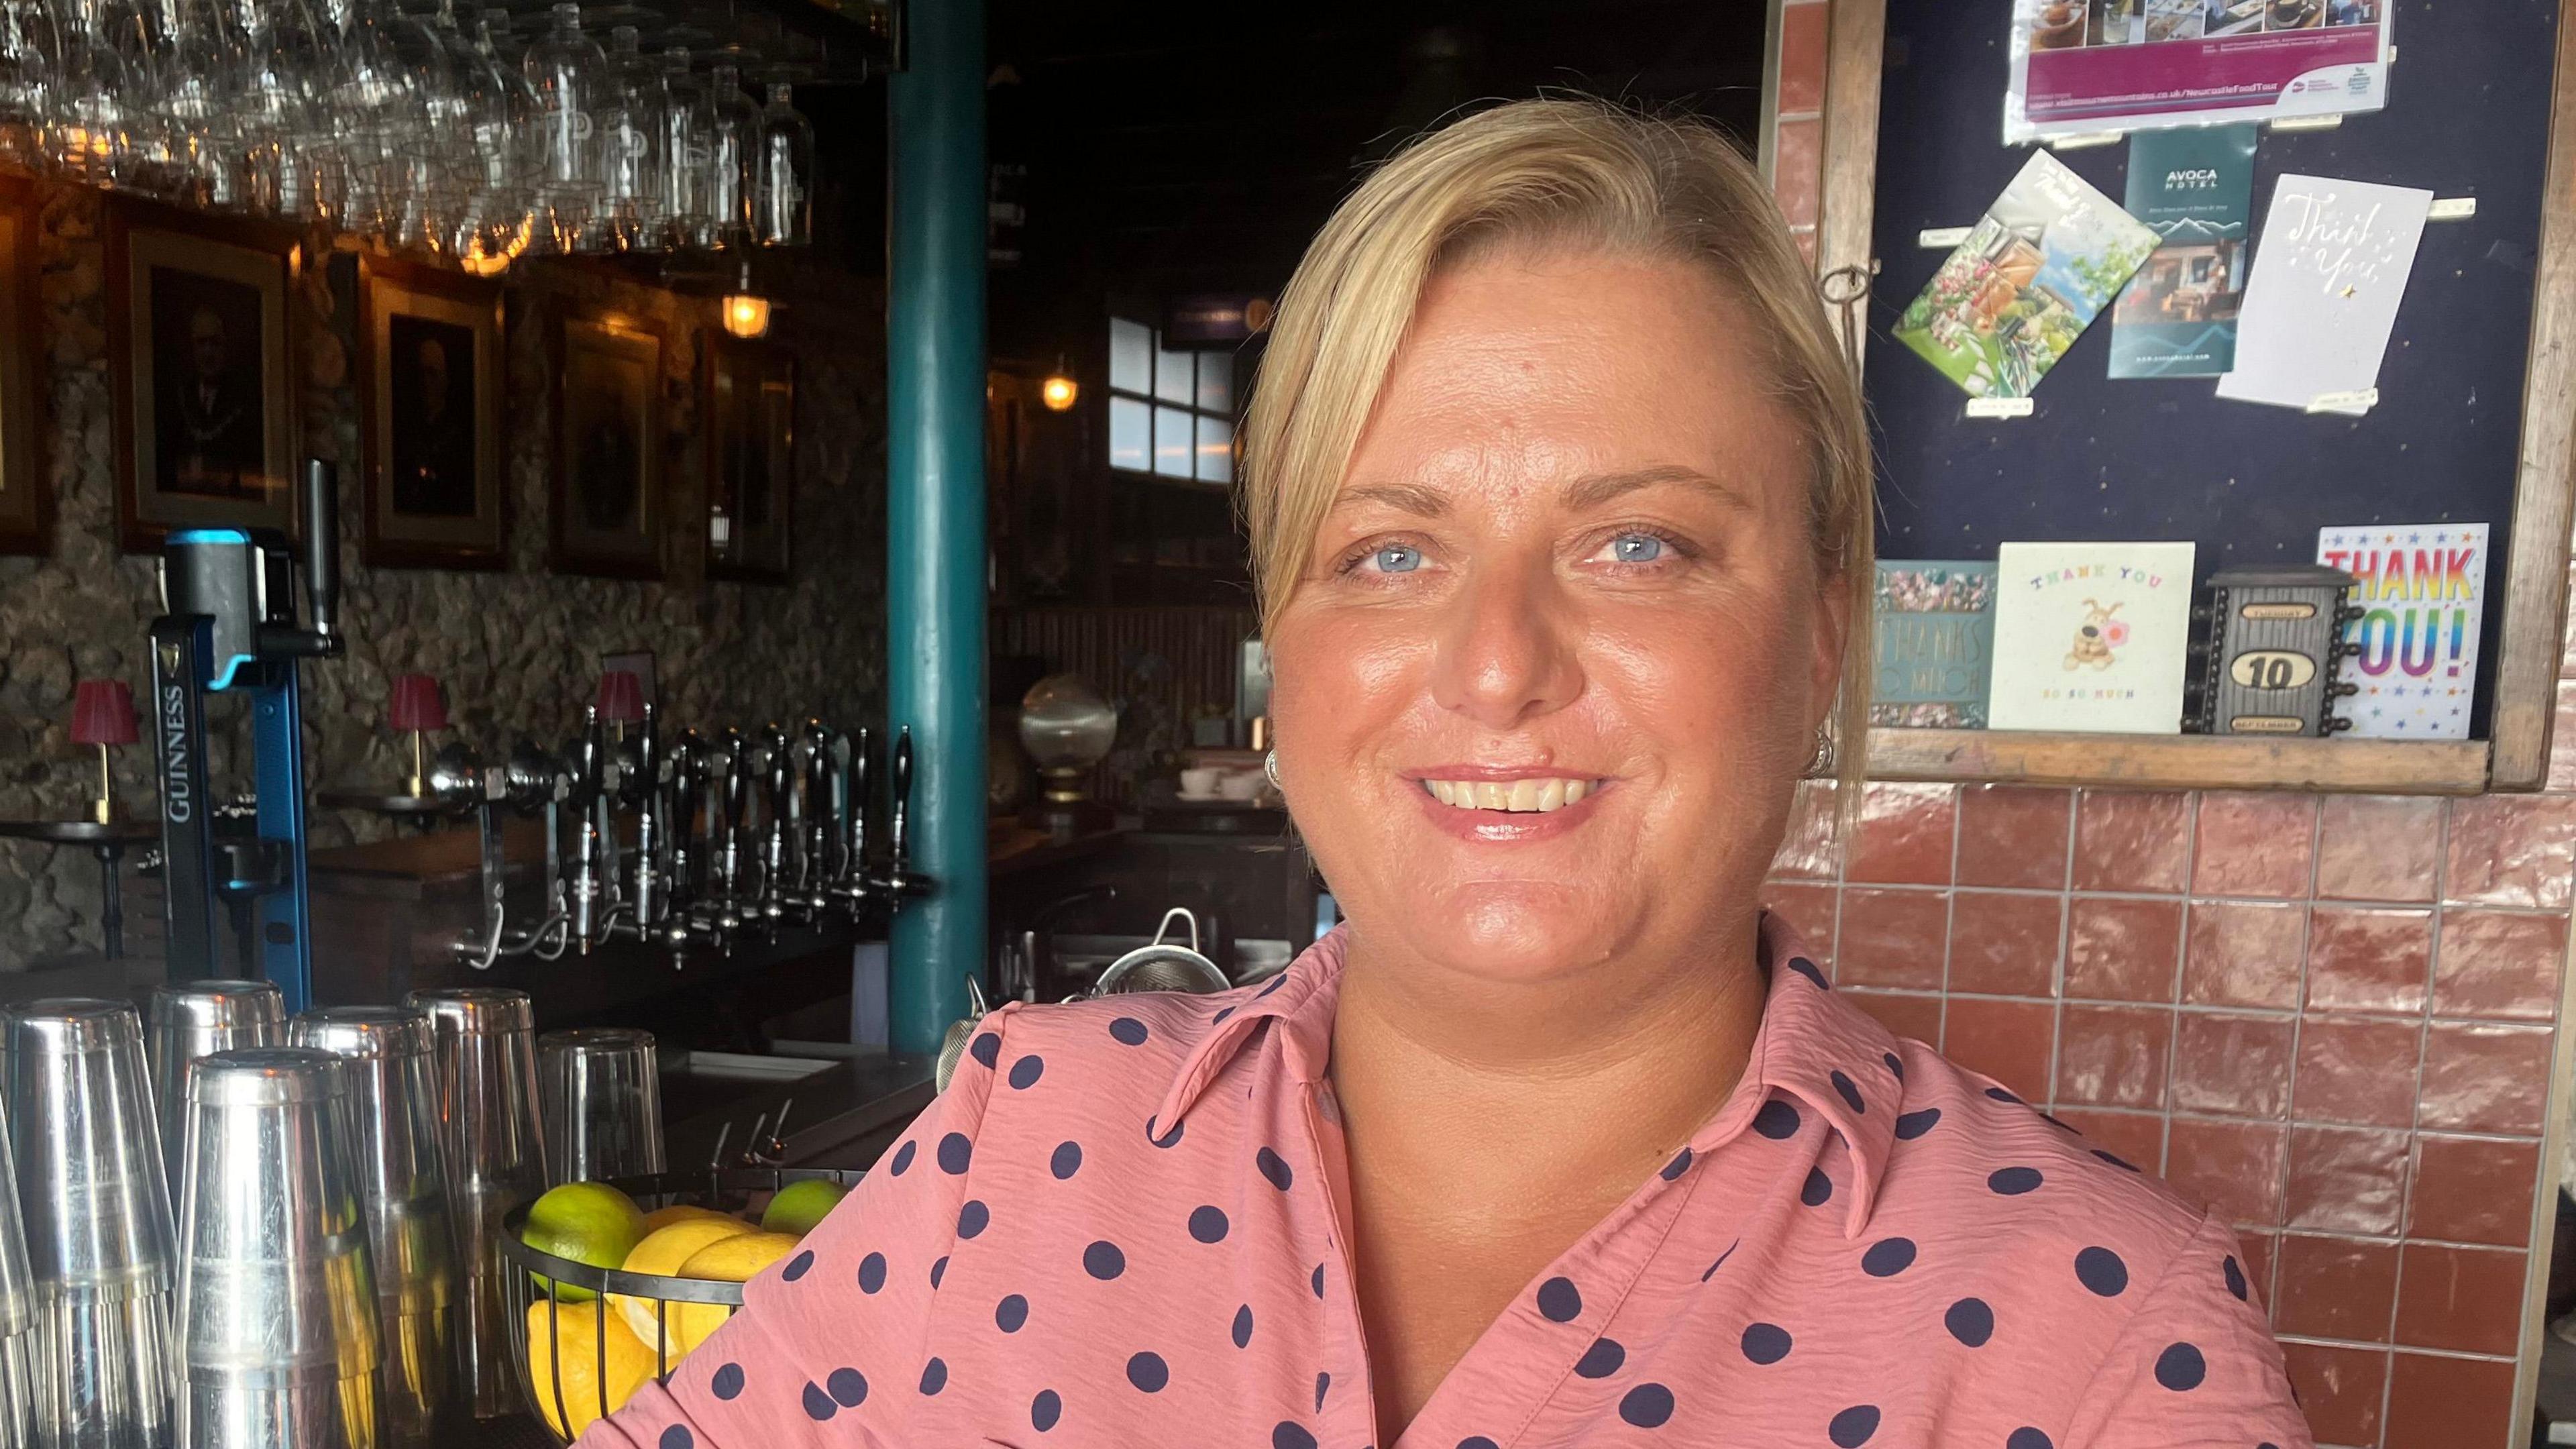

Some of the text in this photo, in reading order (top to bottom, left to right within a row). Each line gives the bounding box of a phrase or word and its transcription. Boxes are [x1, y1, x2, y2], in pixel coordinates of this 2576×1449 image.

[2165, 181, 2218, 190] HOTEL
[2167, 169, 2217, 181] AVOCA
[2031, 566, 2162, 590] THANK YOU
[2343, 607, 2465, 678] OU!
[2249, 656, 2293, 689] 10
[2043, 688, 2135, 700] SO SO MUCH
[165, 685, 191, 824] GUINNESS
